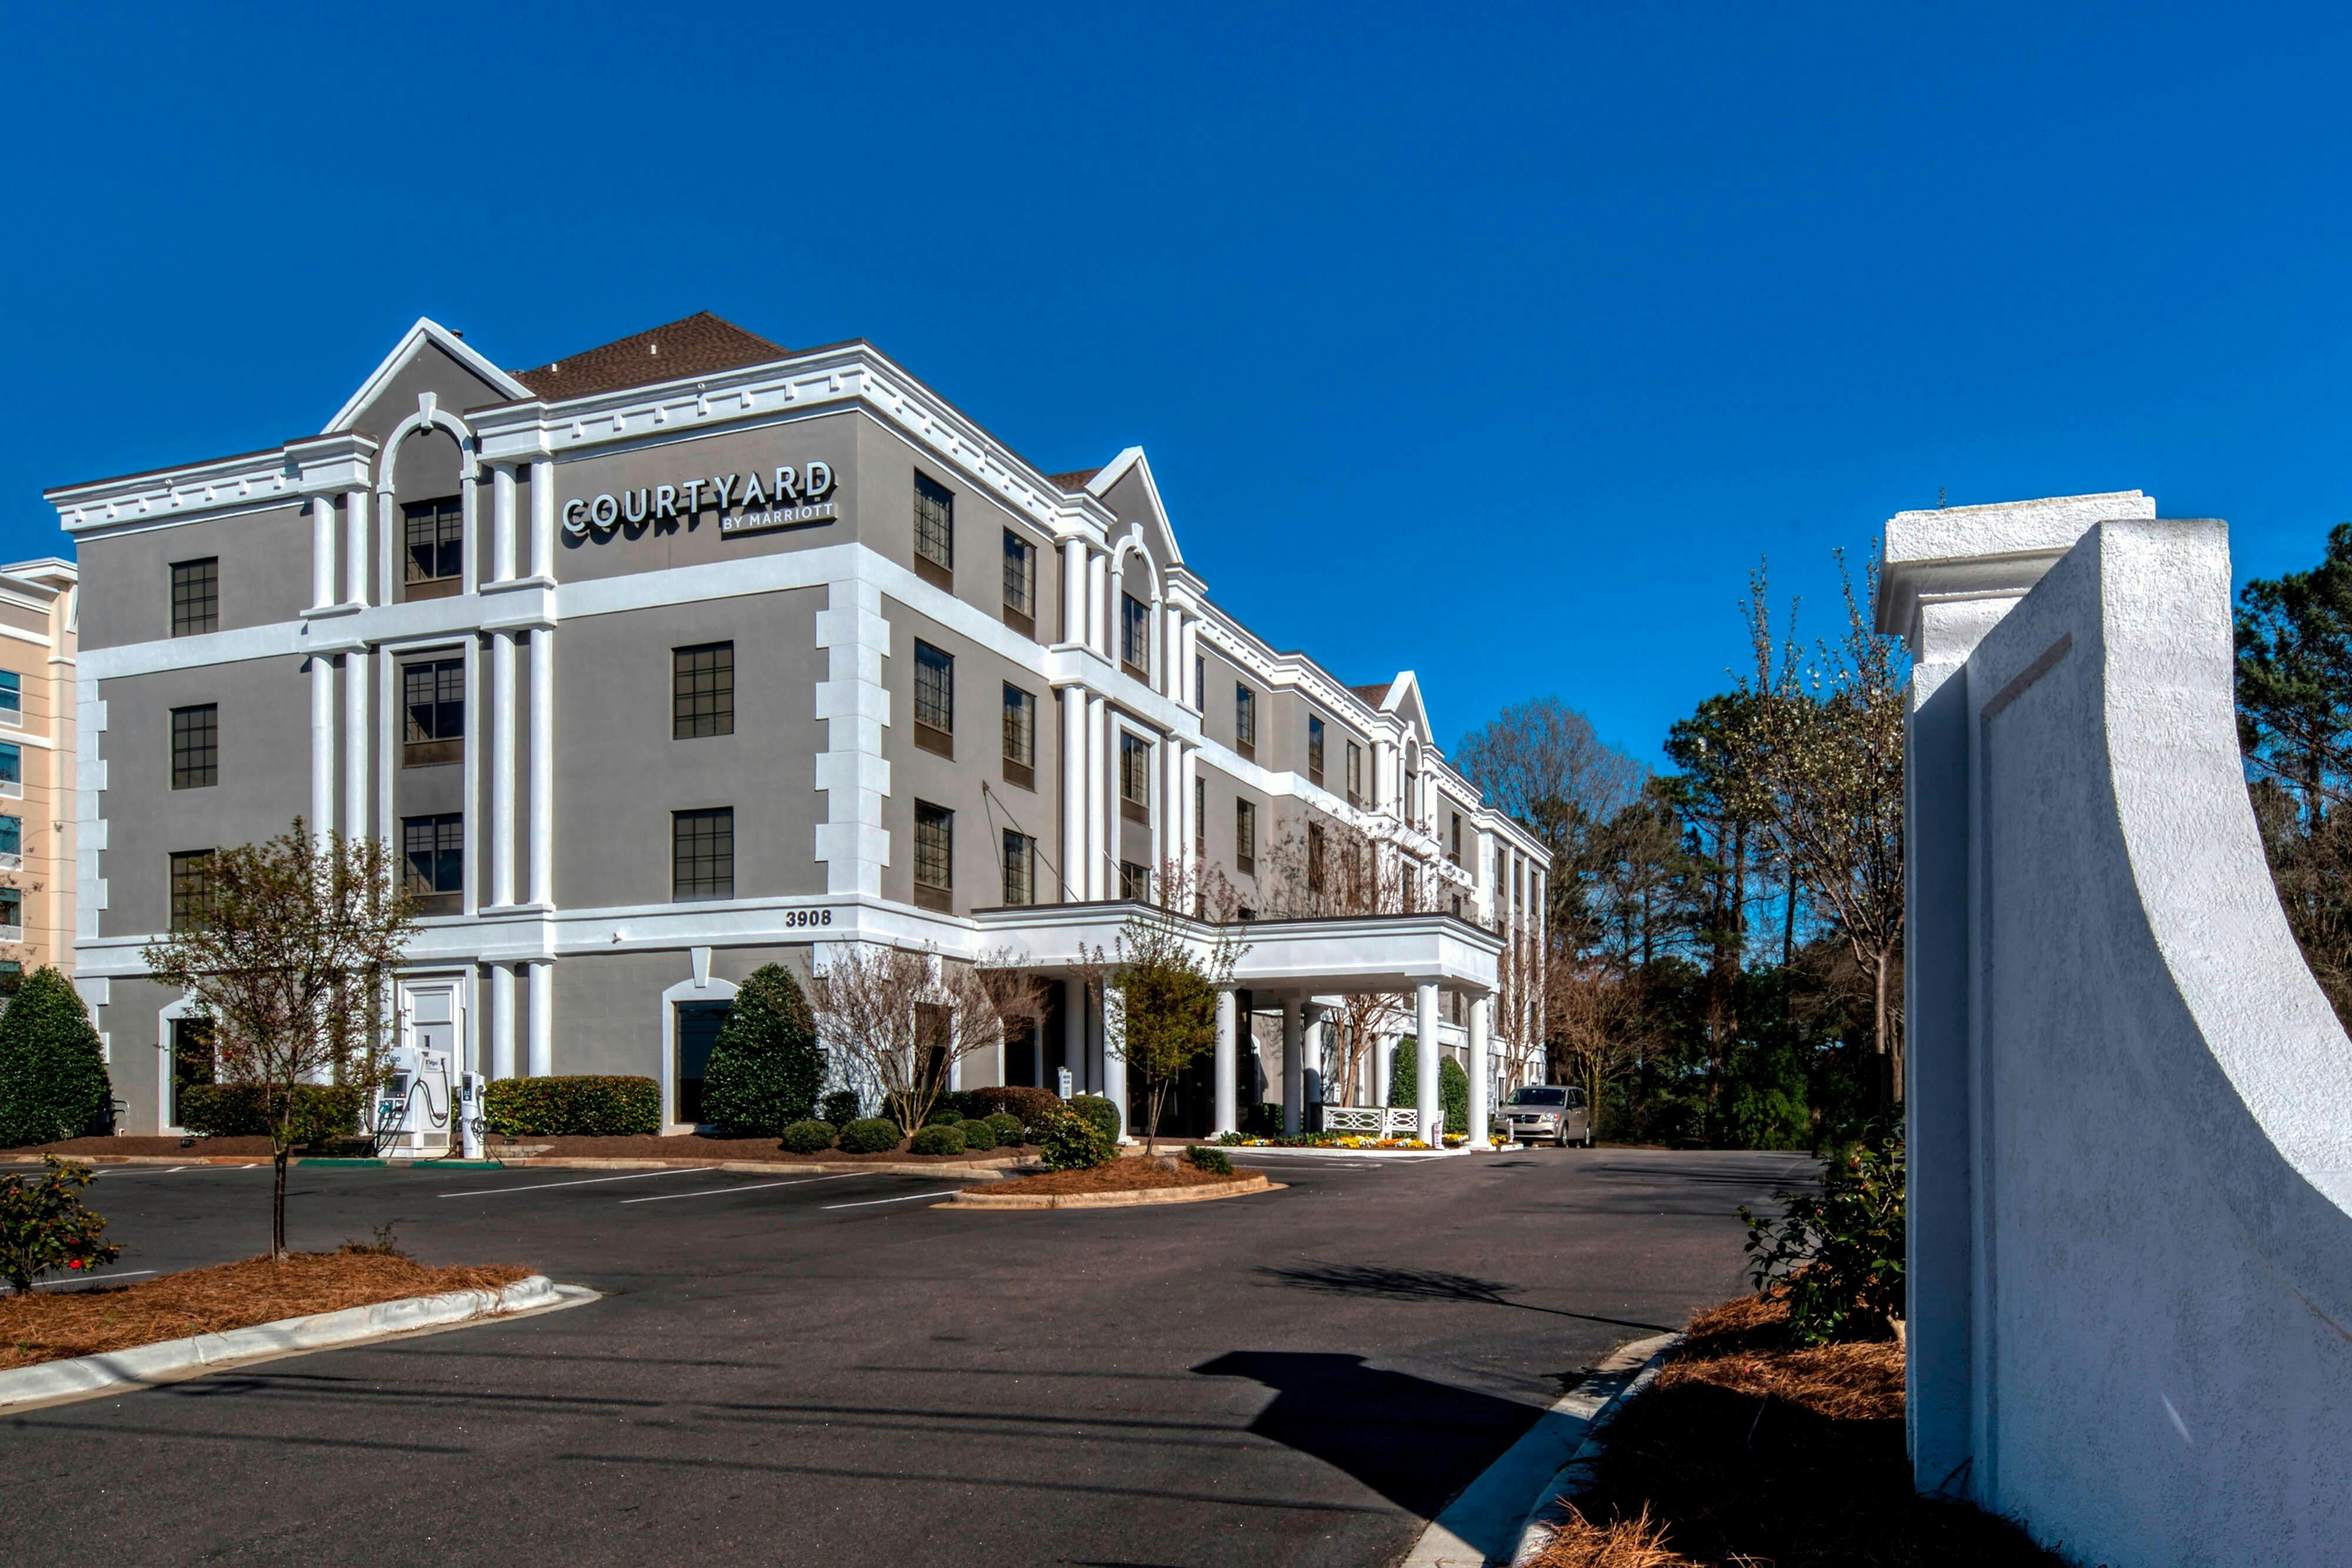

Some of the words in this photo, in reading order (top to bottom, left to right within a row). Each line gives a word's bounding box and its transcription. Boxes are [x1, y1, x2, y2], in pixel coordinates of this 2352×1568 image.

[562, 461, 832, 532] COURTYARD
[724, 516, 742, 530] BY
[749, 503, 833, 526] MARRIOTT
[786, 910, 831, 927] 3908
